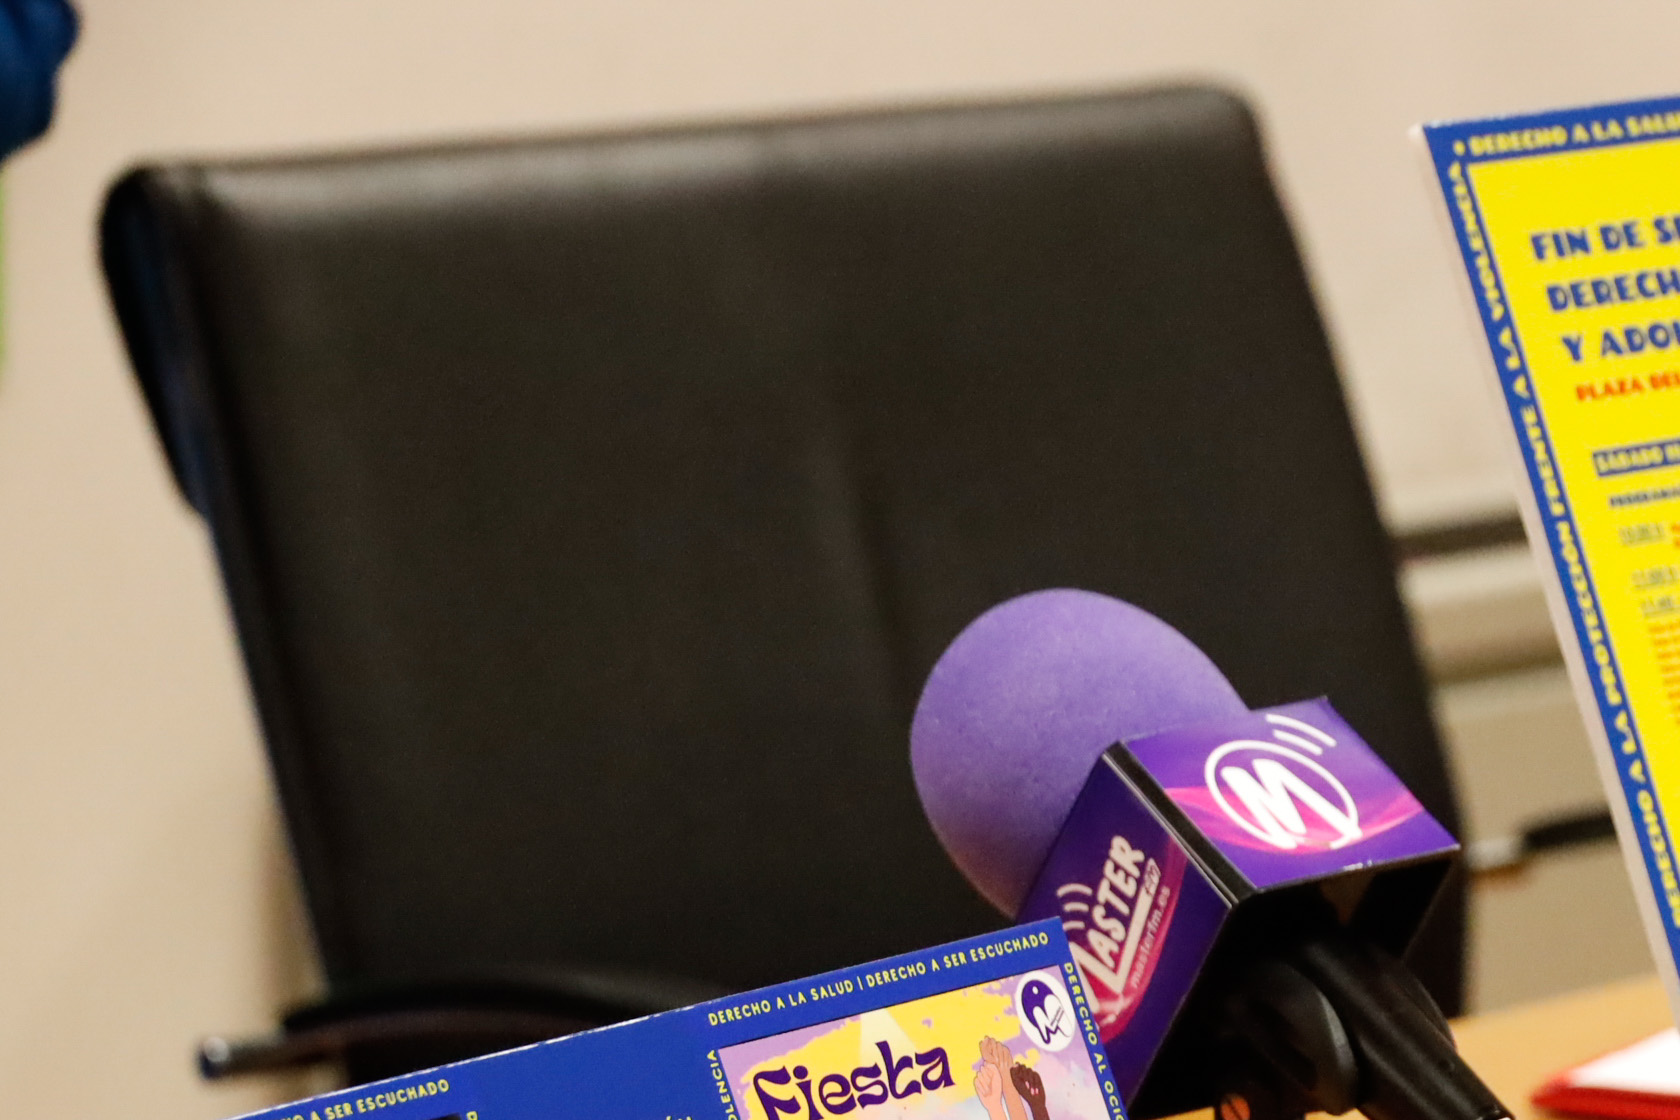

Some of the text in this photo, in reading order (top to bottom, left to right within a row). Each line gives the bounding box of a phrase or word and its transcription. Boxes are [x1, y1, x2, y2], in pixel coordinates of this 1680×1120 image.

[1529, 225, 1596, 261] FIN
[1598, 219, 1645, 252] DE
[1561, 333, 1589, 363] Y
[1069, 835, 1146, 1014] MASTER
[865, 931, 1050, 987] DERECHO A SER ESCUCHADO
[707, 979, 855, 1026] DERECHO A LA SALUD
[323, 1102, 354, 1120] SER
[355, 1078, 451, 1113] ESCUCHADO
